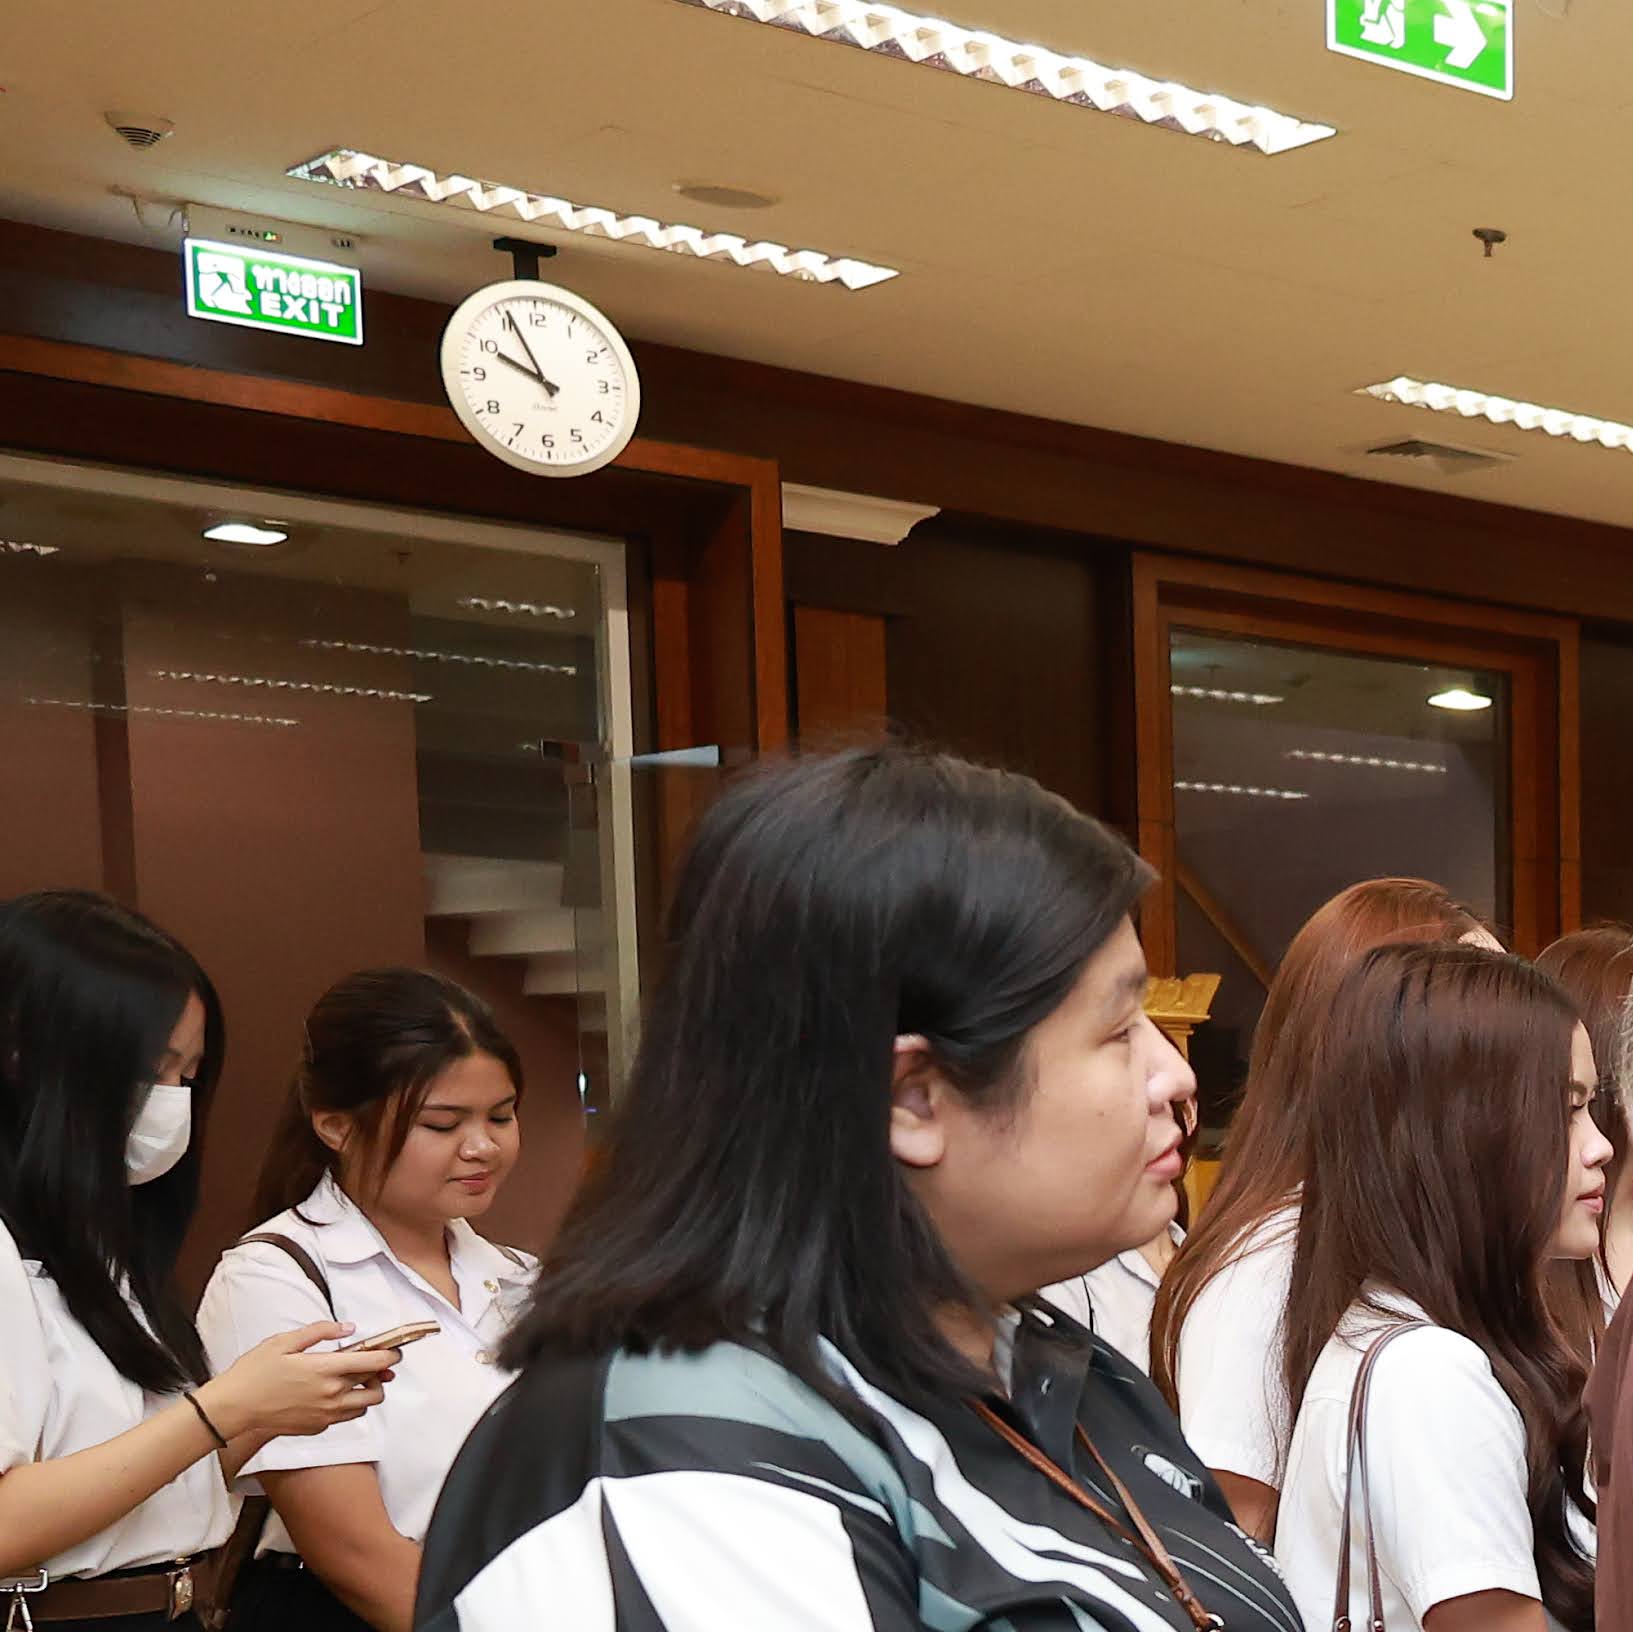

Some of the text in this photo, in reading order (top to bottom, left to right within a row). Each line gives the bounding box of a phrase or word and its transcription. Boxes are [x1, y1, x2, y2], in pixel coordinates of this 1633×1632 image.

[260, 291, 344, 327] EXIT
[529, 313, 546, 328] 12
[479, 339, 498, 354] 10
[586, 351, 598, 364] 2
[473, 367, 486, 381] 9
[597, 380, 609, 393] 3
[487, 400, 500, 414] 8
[590, 410, 603, 423] 4
[512, 423, 524, 437] 7
[570, 429, 582, 443] 5
[542, 434, 554, 448] 6
